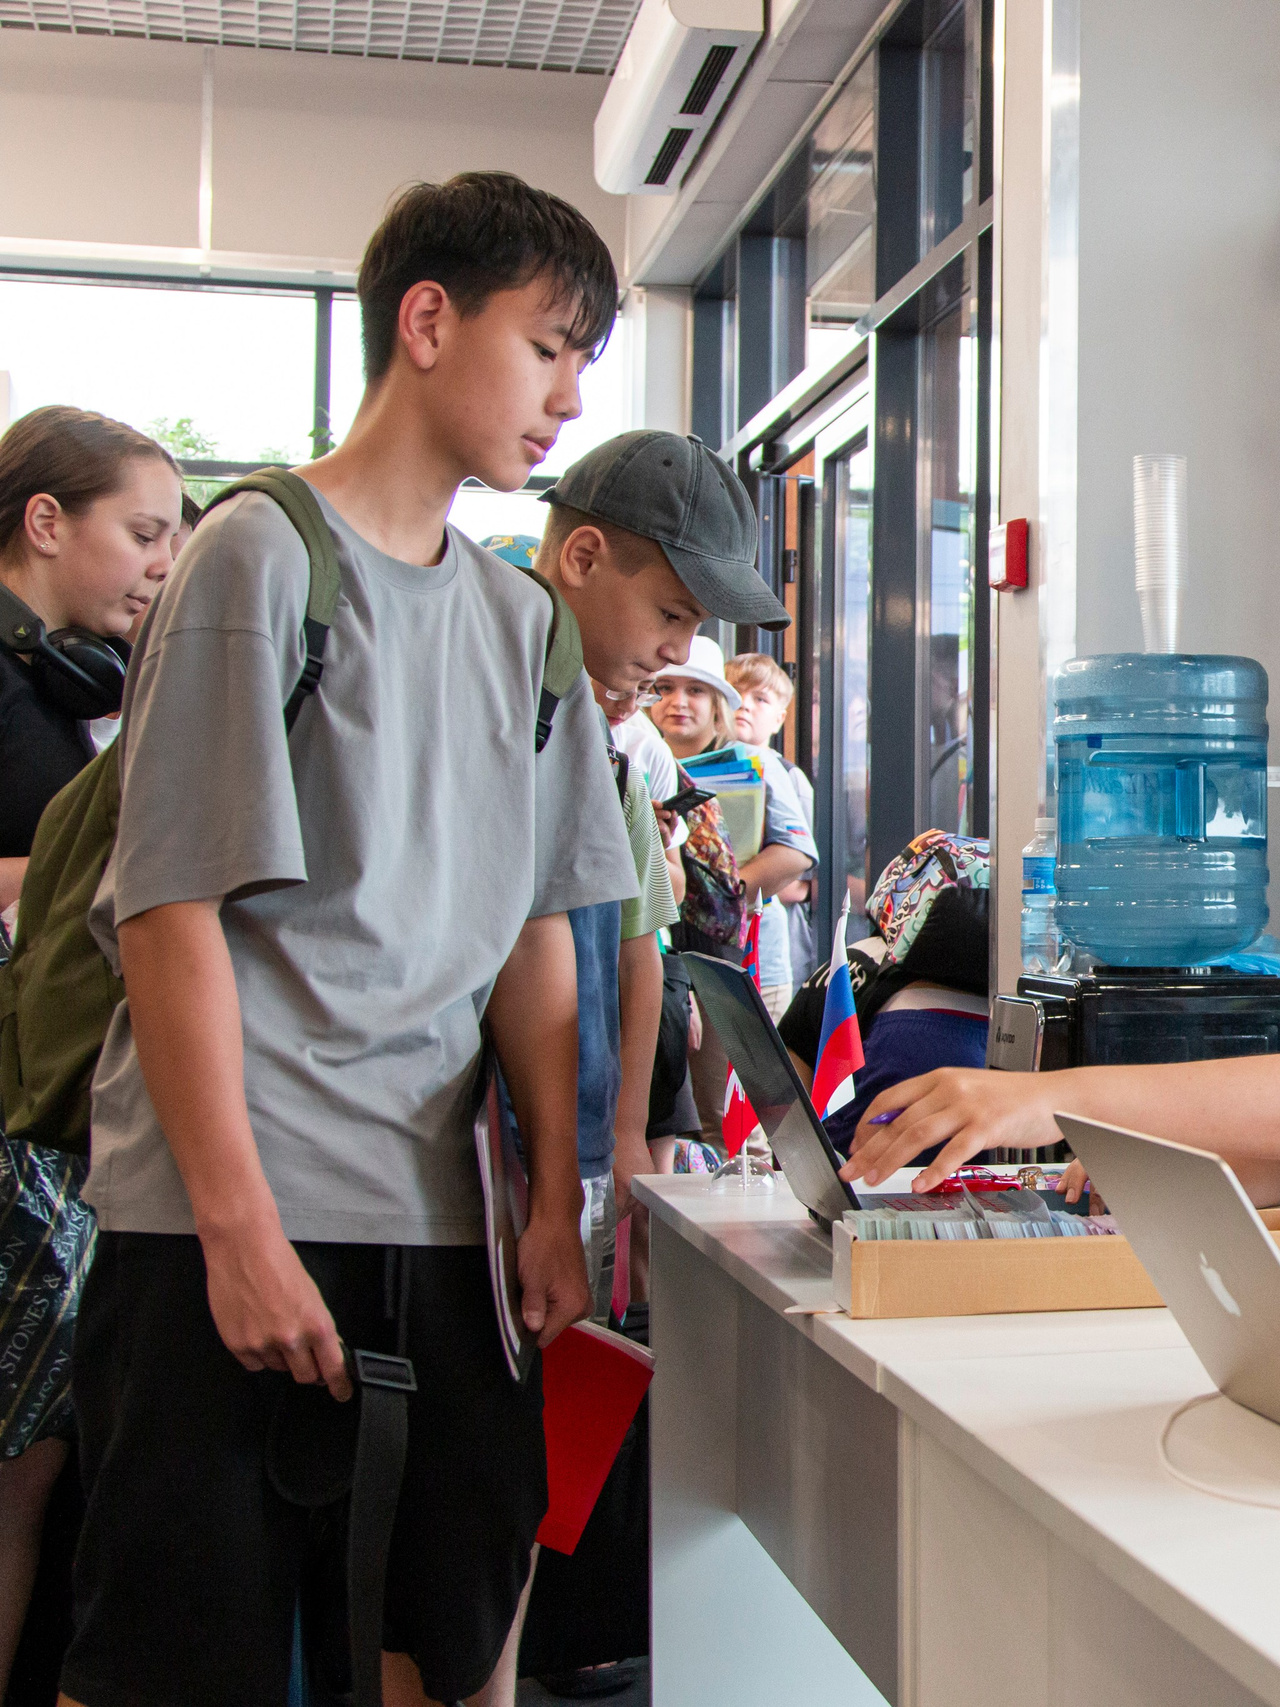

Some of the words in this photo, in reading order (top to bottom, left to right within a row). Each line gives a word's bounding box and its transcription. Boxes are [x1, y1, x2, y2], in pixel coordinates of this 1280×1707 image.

[0, 1294, 50, 1375] STONES
[43, 1273, 63, 1290] &
[55, 1198, 90, 1262] SAMSO
